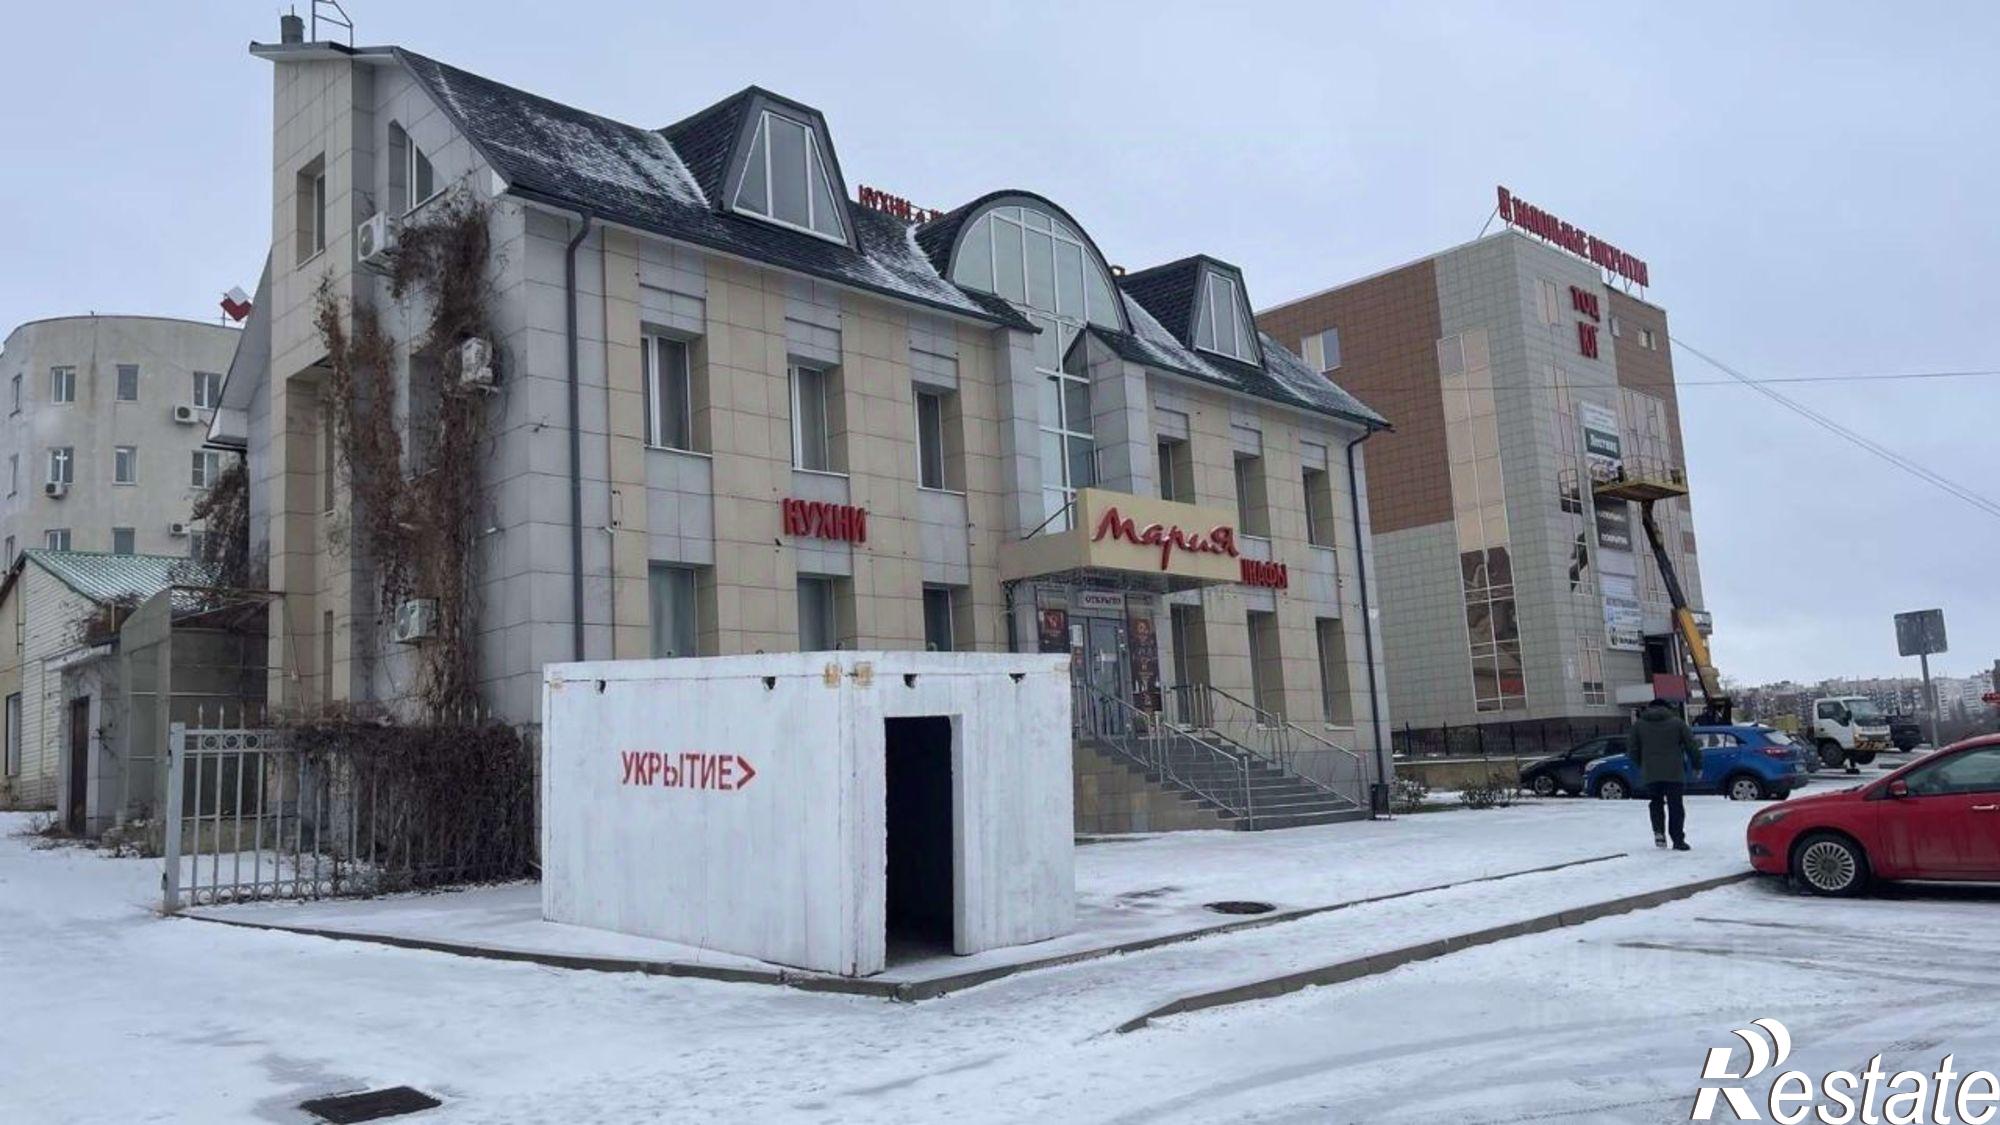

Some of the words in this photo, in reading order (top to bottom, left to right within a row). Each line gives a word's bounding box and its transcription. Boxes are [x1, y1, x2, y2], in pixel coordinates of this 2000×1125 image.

[1589, 235, 1649, 287] ПОКРЫТИЯ
[783, 498, 866, 542] КУХНИ
[1091, 507, 1239, 570] Мария
[621, 750, 733, 790] УКРЫТИЕ
